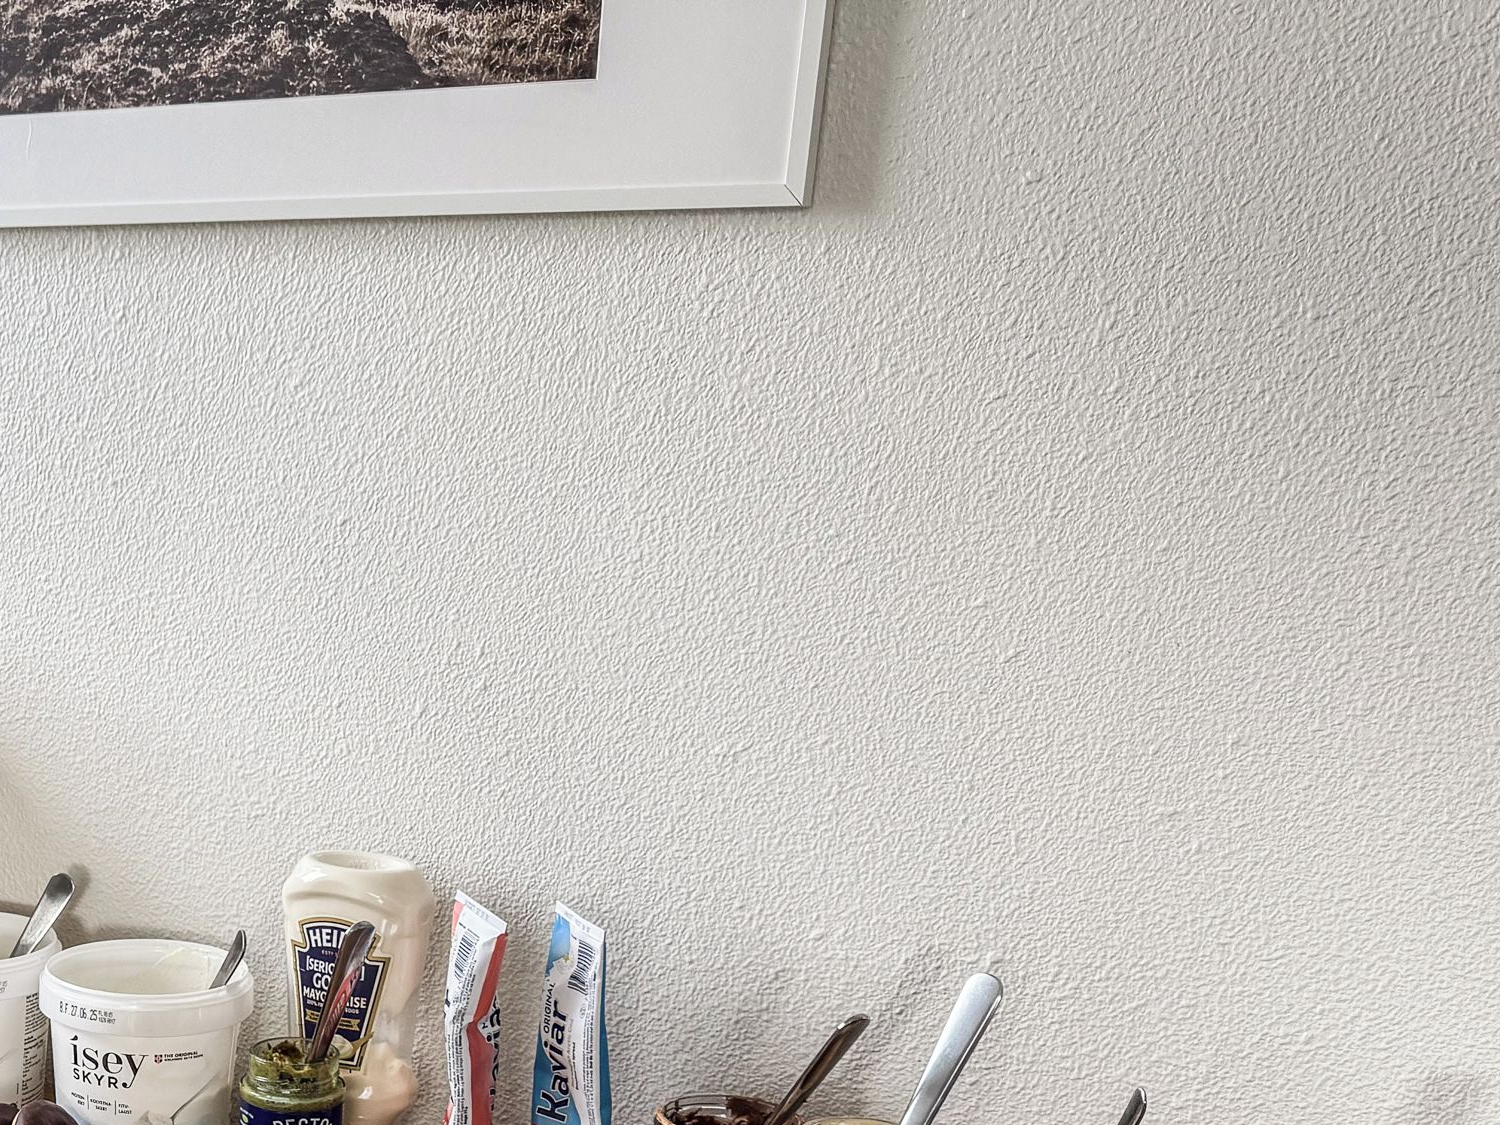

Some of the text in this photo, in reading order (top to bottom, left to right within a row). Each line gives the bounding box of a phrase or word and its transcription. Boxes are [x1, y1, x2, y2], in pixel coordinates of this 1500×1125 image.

[308, 928, 346, 949] HEI
[543, 982, 556, 1034] ORIGINAL
[73, 1067, 118, 1090] SKYR
[535, 999, 570, 1124] Kaviar
